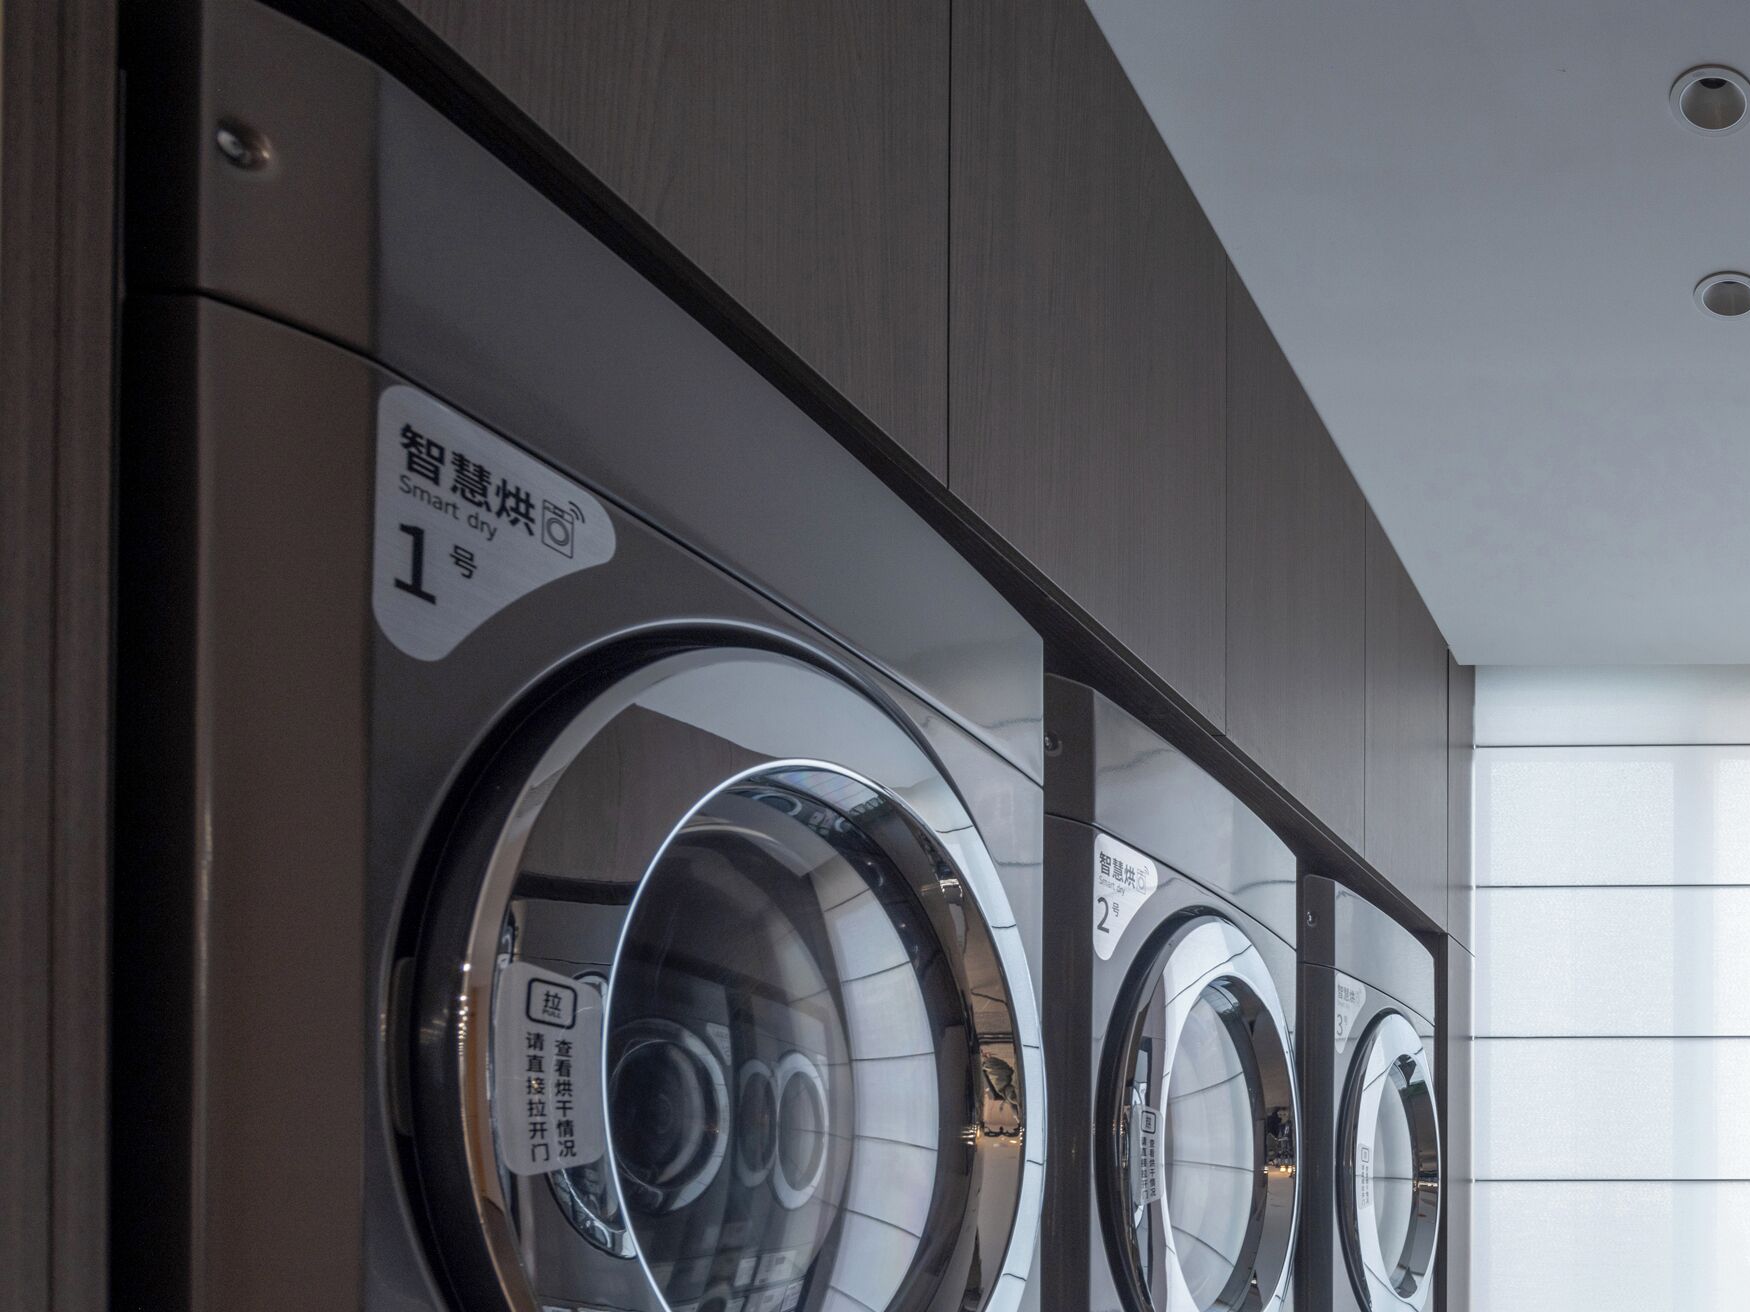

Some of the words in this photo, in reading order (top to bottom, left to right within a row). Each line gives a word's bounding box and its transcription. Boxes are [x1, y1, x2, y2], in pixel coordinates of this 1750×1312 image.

[399, 474, 460, 521] Smart
[466, 511, 498, 542] dry
[400, 424, 536, 537] 智慧烘
[394, 523, 437, 605] 1
[450, 544, 478, 580] 号
[1099, 851, 1136, 889] 智慧烘
[1097, 896, 1111, 935] 2
[544, 991, 562, 1012] 拉
[1336, 1014, 1344, 1037] 3
[526, 1032, 550, 1163] 请直接拉开门
[554, 1039, 577, 1158] 查看烘干情况
